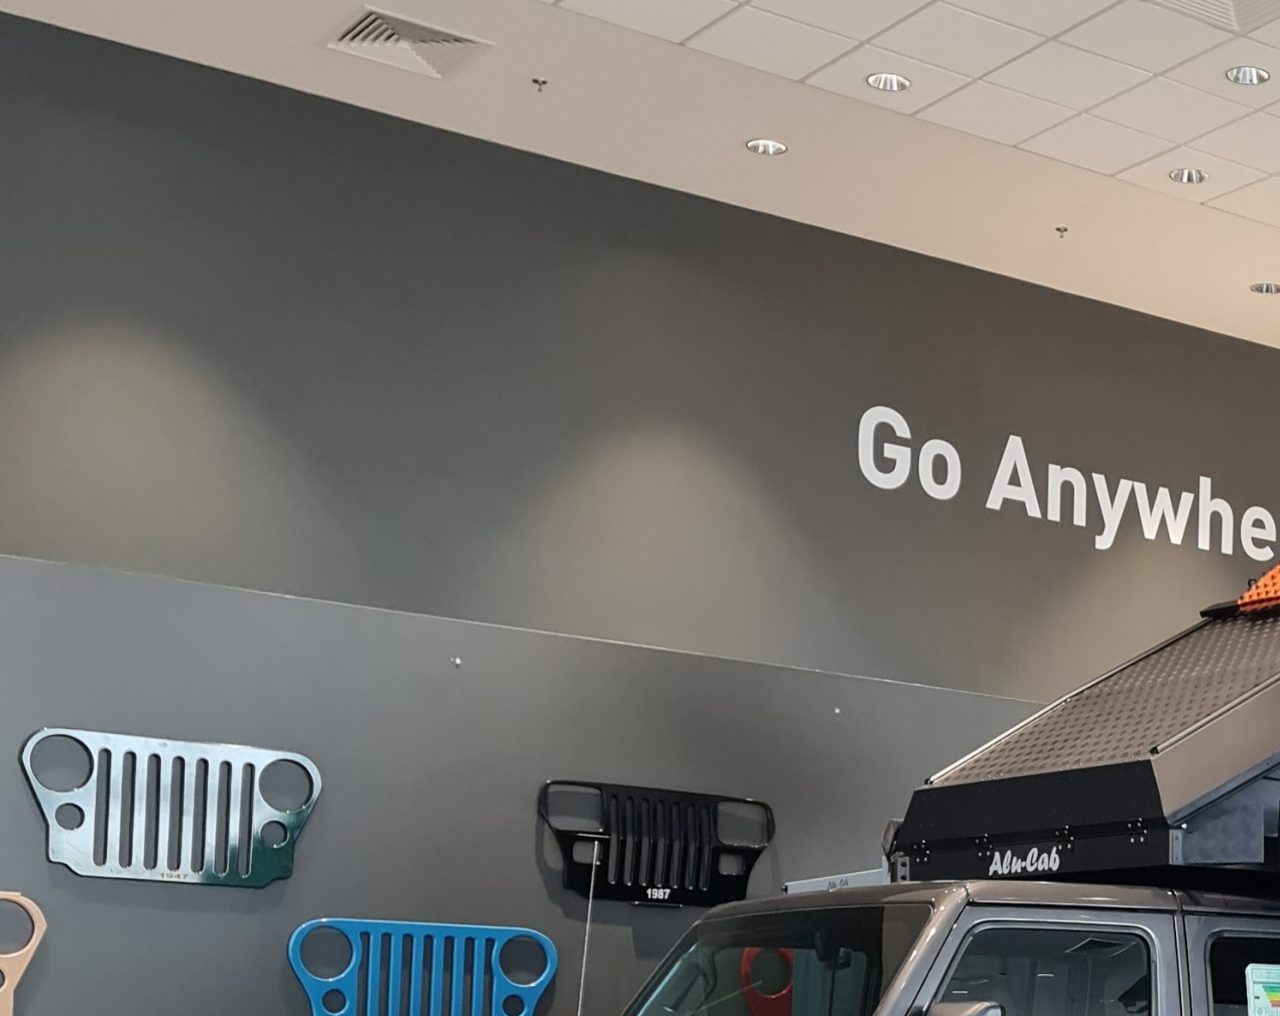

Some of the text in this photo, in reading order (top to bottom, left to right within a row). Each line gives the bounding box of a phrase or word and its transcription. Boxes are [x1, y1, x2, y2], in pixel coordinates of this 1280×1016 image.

[858, 406, 962, 500] Go
[988, 843, 1060, 877] Alu-Cab
[646, 887, 671, 899] 1987
